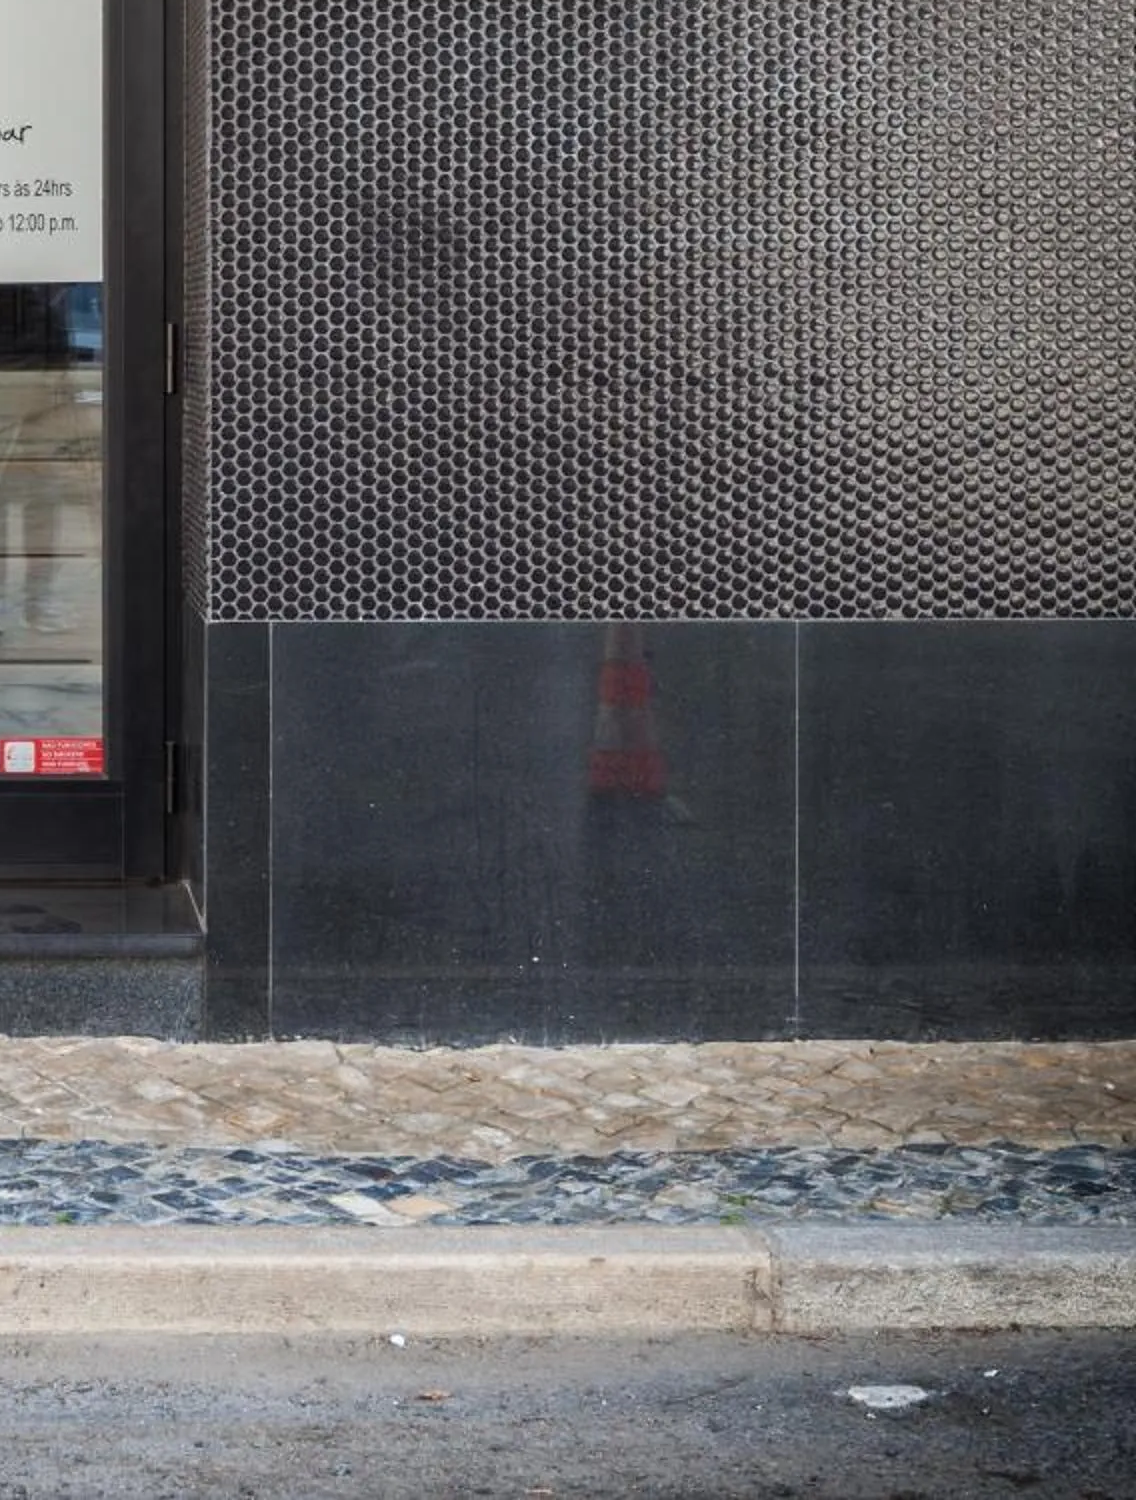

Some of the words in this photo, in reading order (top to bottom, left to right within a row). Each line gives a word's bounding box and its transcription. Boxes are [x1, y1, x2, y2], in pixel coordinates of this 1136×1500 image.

[34, 179, 74, 198] 24hrs
[8, 213, 45, 232] 12:00
[48, 217, 80, 236] p.m.
